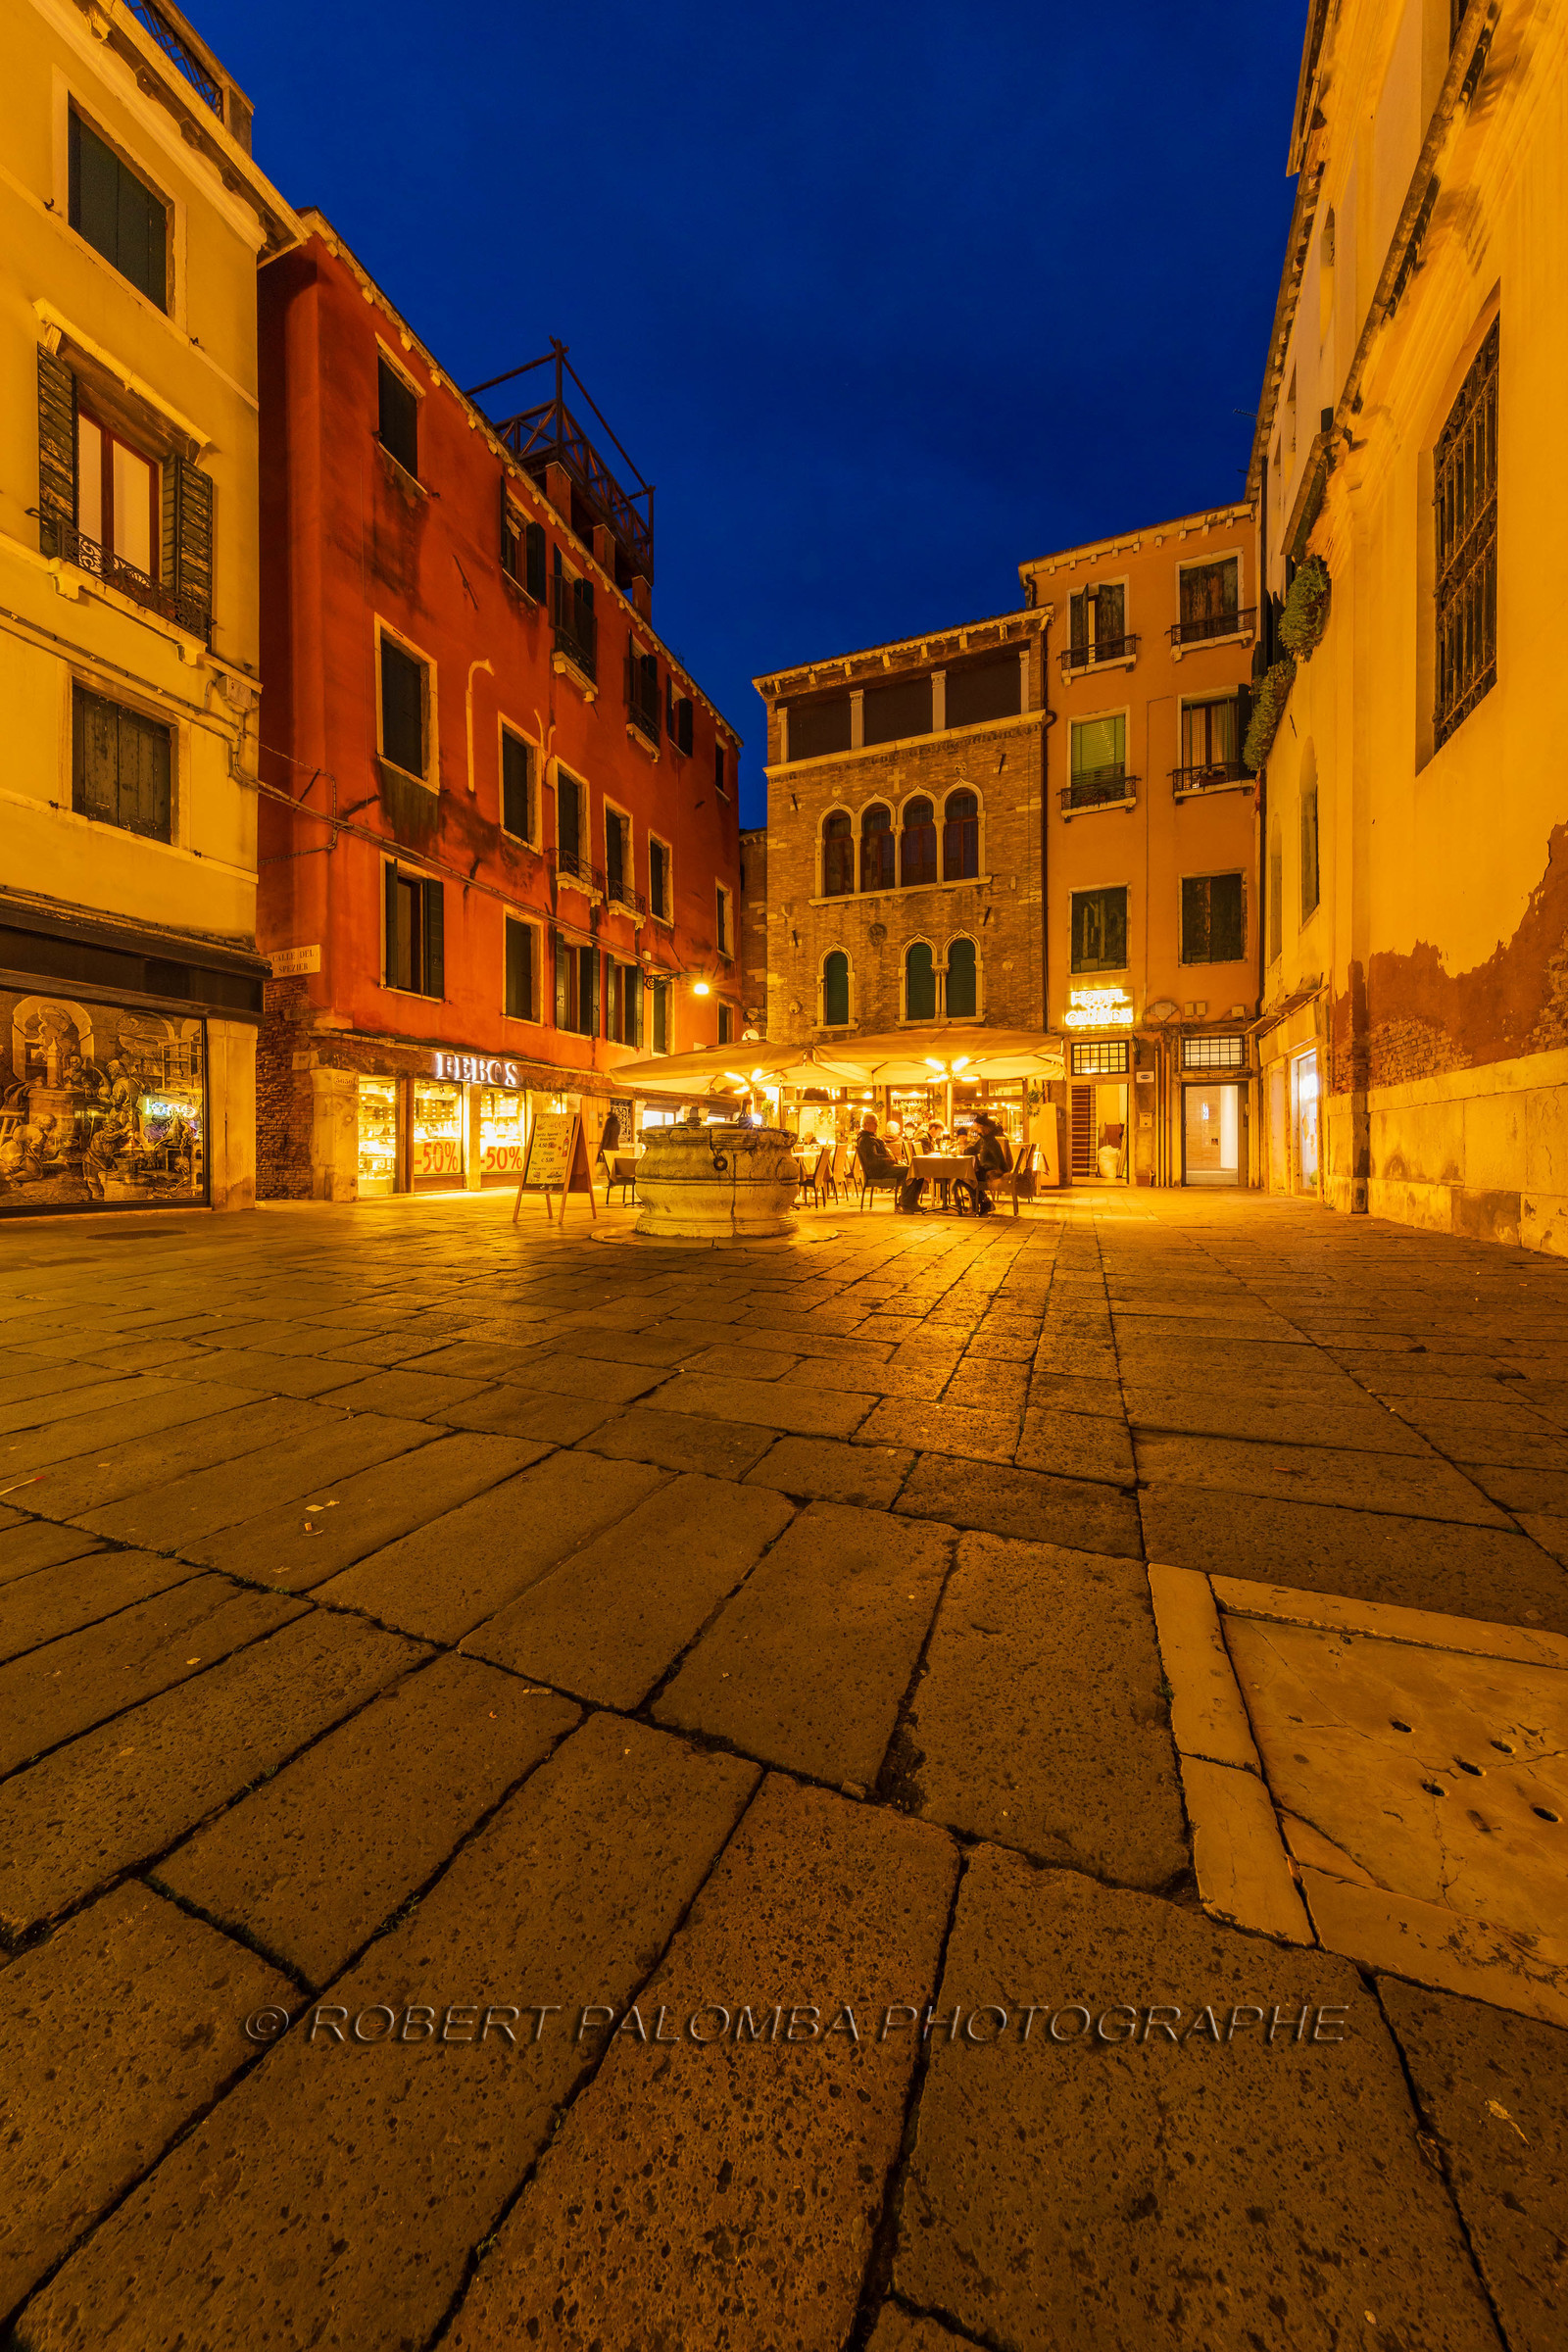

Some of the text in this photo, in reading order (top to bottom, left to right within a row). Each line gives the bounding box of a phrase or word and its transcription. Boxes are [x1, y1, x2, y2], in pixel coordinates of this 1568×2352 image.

[272, 949, 314, 961] CALLE DEL
[278, 963, 309, 973] SPEZIER
[436, 1053, 520, 1087] FEBOS
[415, 1142, 459, 1173] -50%
[480, 1146, 522, 1170] -50%
